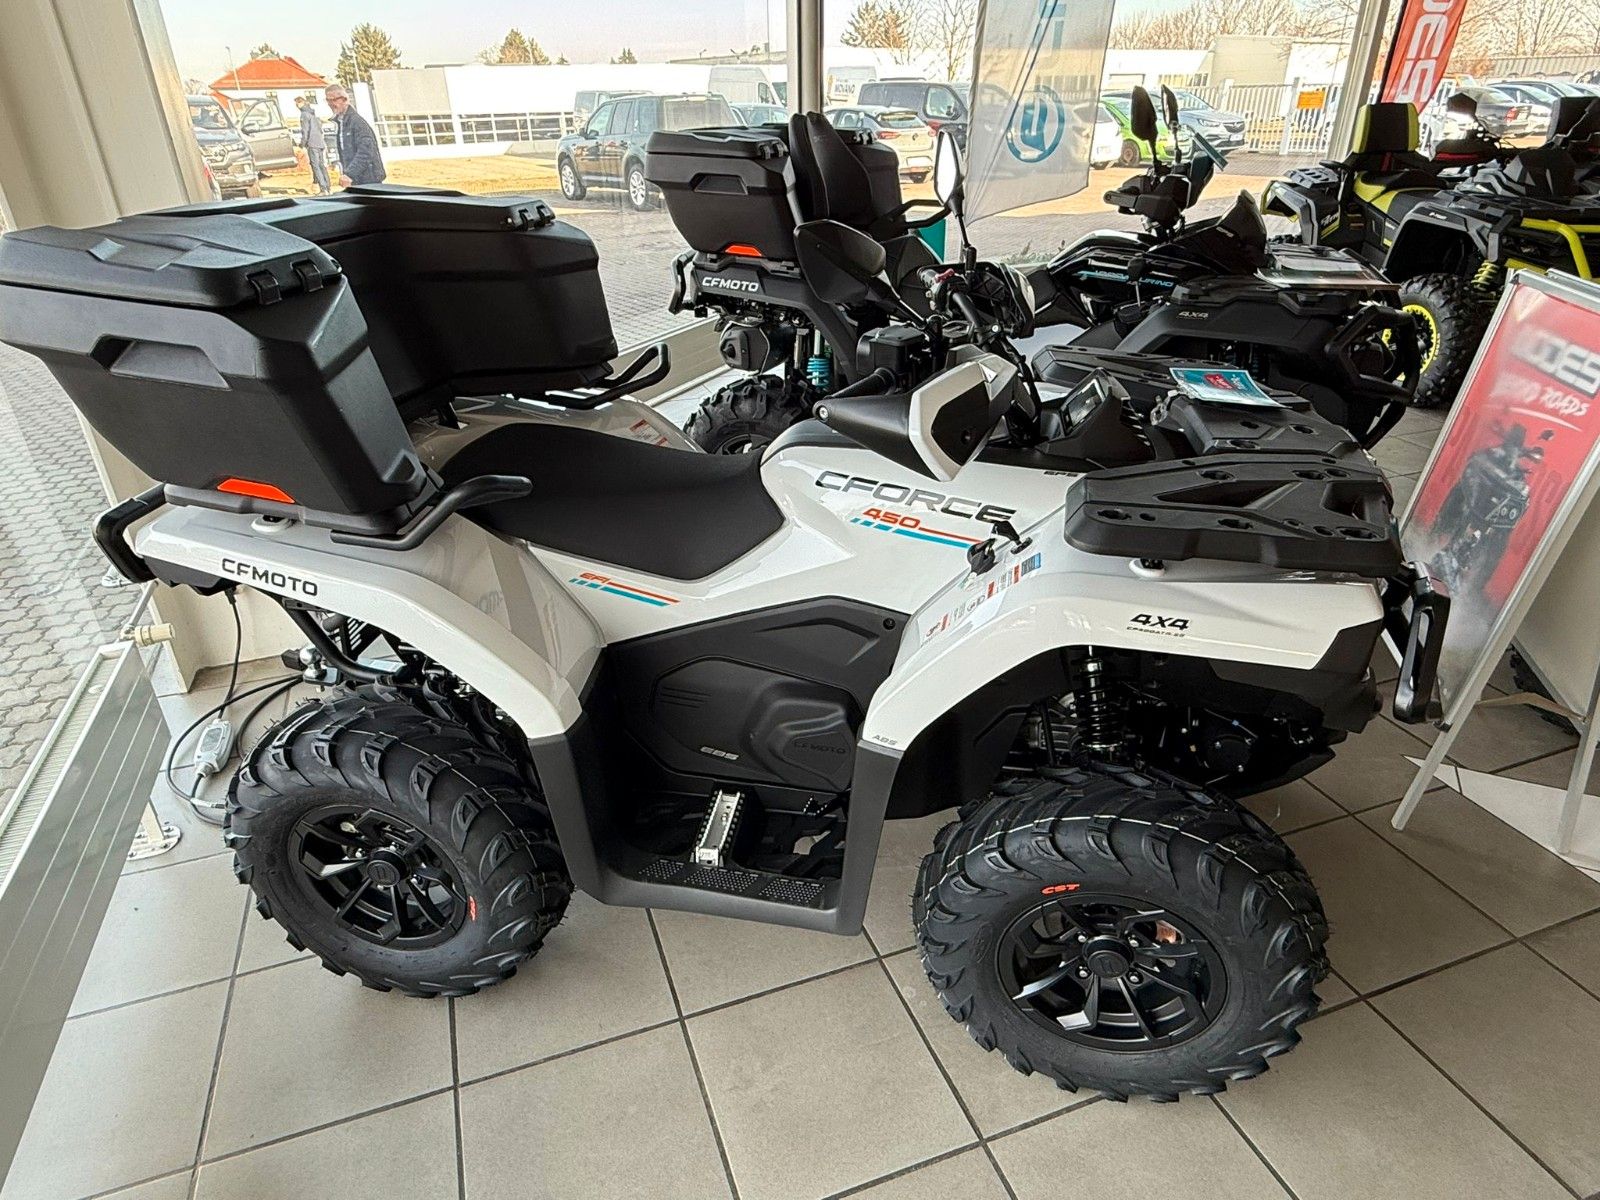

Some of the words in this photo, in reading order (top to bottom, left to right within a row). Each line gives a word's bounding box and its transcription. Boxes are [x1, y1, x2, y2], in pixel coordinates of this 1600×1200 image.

[702, 276, 759, 292] CFMOTO
[815, 470, 1016, 524] CFORCE
[863, 508, 921, 529] 450
[222, 558, 318, 596] CFMOTO
[871, 734, 898, 746] ABS
[1041, 883, 1080, 895] CST
